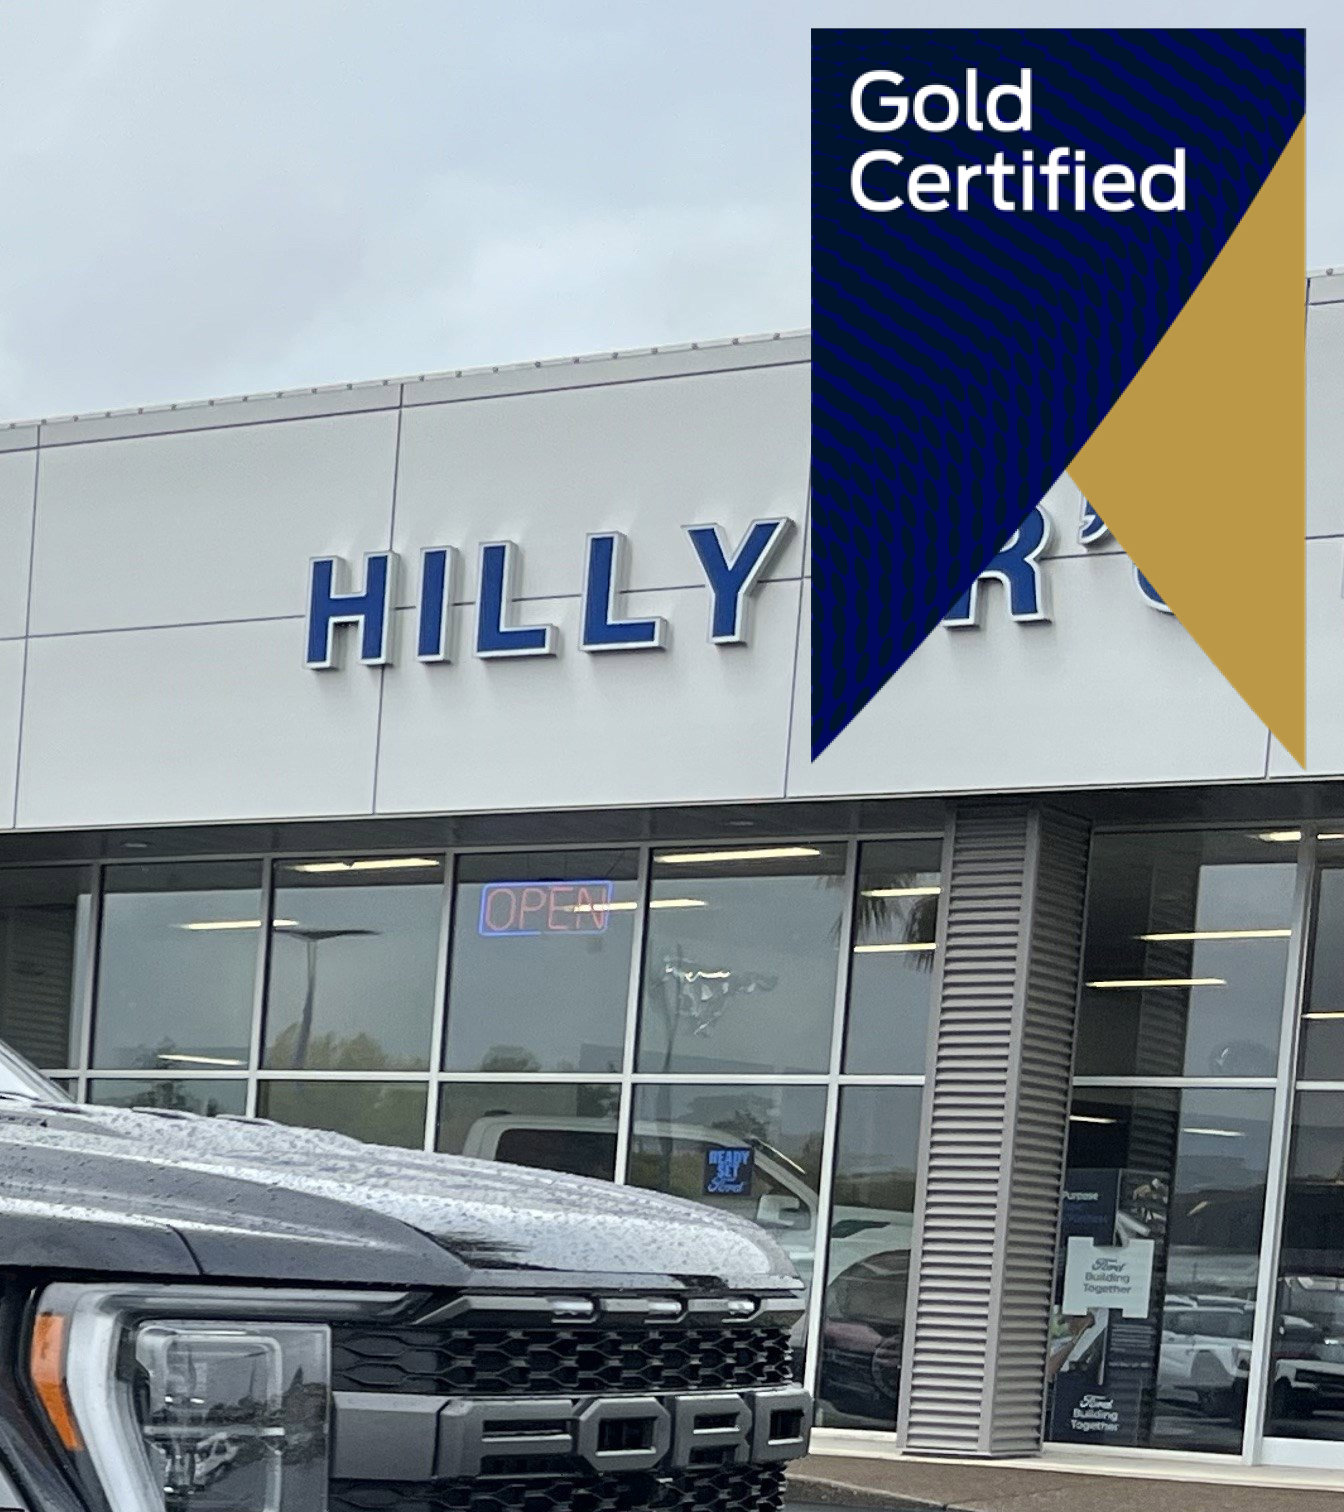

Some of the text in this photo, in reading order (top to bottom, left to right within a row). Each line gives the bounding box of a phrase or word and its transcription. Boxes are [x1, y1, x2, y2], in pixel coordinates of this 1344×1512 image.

[484, 886, 607, 932] OPEN
[1091, 1257, 1127, 1274] Ford
[1084, 1271, 1130, 1285] Building
[1083, 1282, 1133, 1295] Together
[1072, 1408, 1119, 1421] Building
[1070, 1419, 1120, 1432] Together
[431, 1388, 812, 1479] FORD
